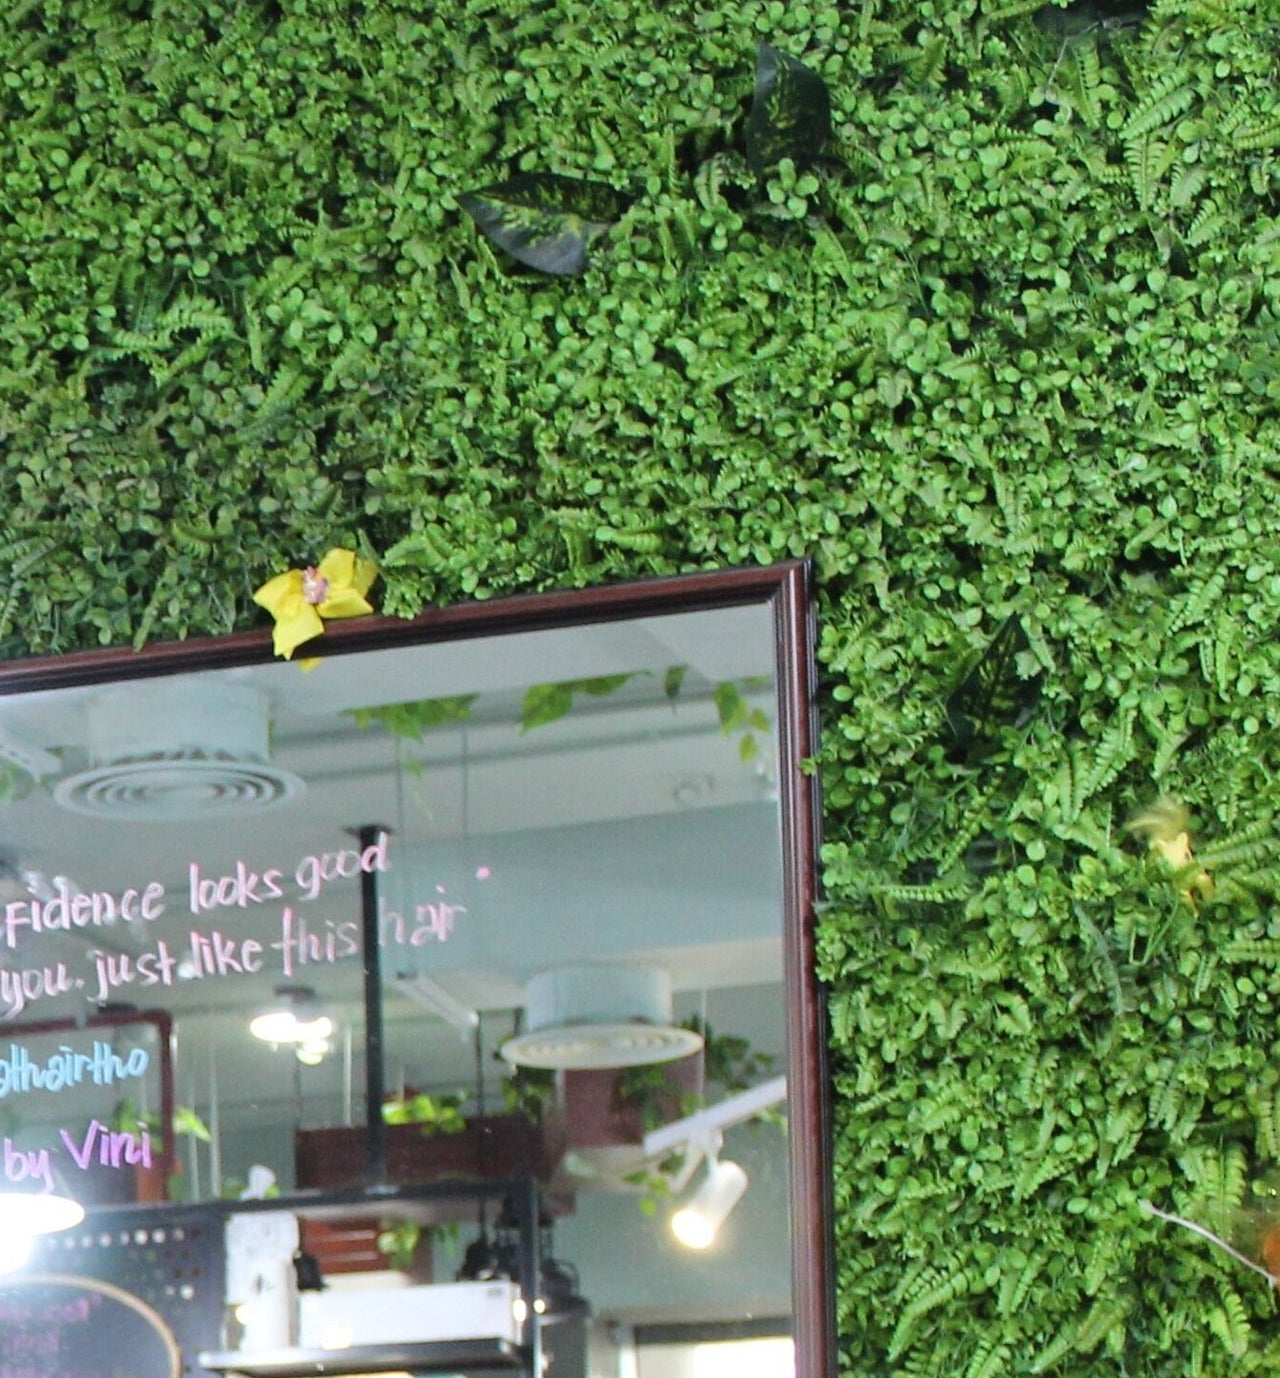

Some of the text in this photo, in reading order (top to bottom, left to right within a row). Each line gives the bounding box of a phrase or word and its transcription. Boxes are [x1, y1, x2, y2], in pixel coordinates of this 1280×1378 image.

[189, 861, 284, 913] looks
[295, 832, 391, 900] good
[87, 941, 175, 1007] just
[190, 931, 264, 979] like
[271, 907, 358, 977] this
[4, 1137, 55, 1194] by
[60, 1119, 153, 1170] Vini
